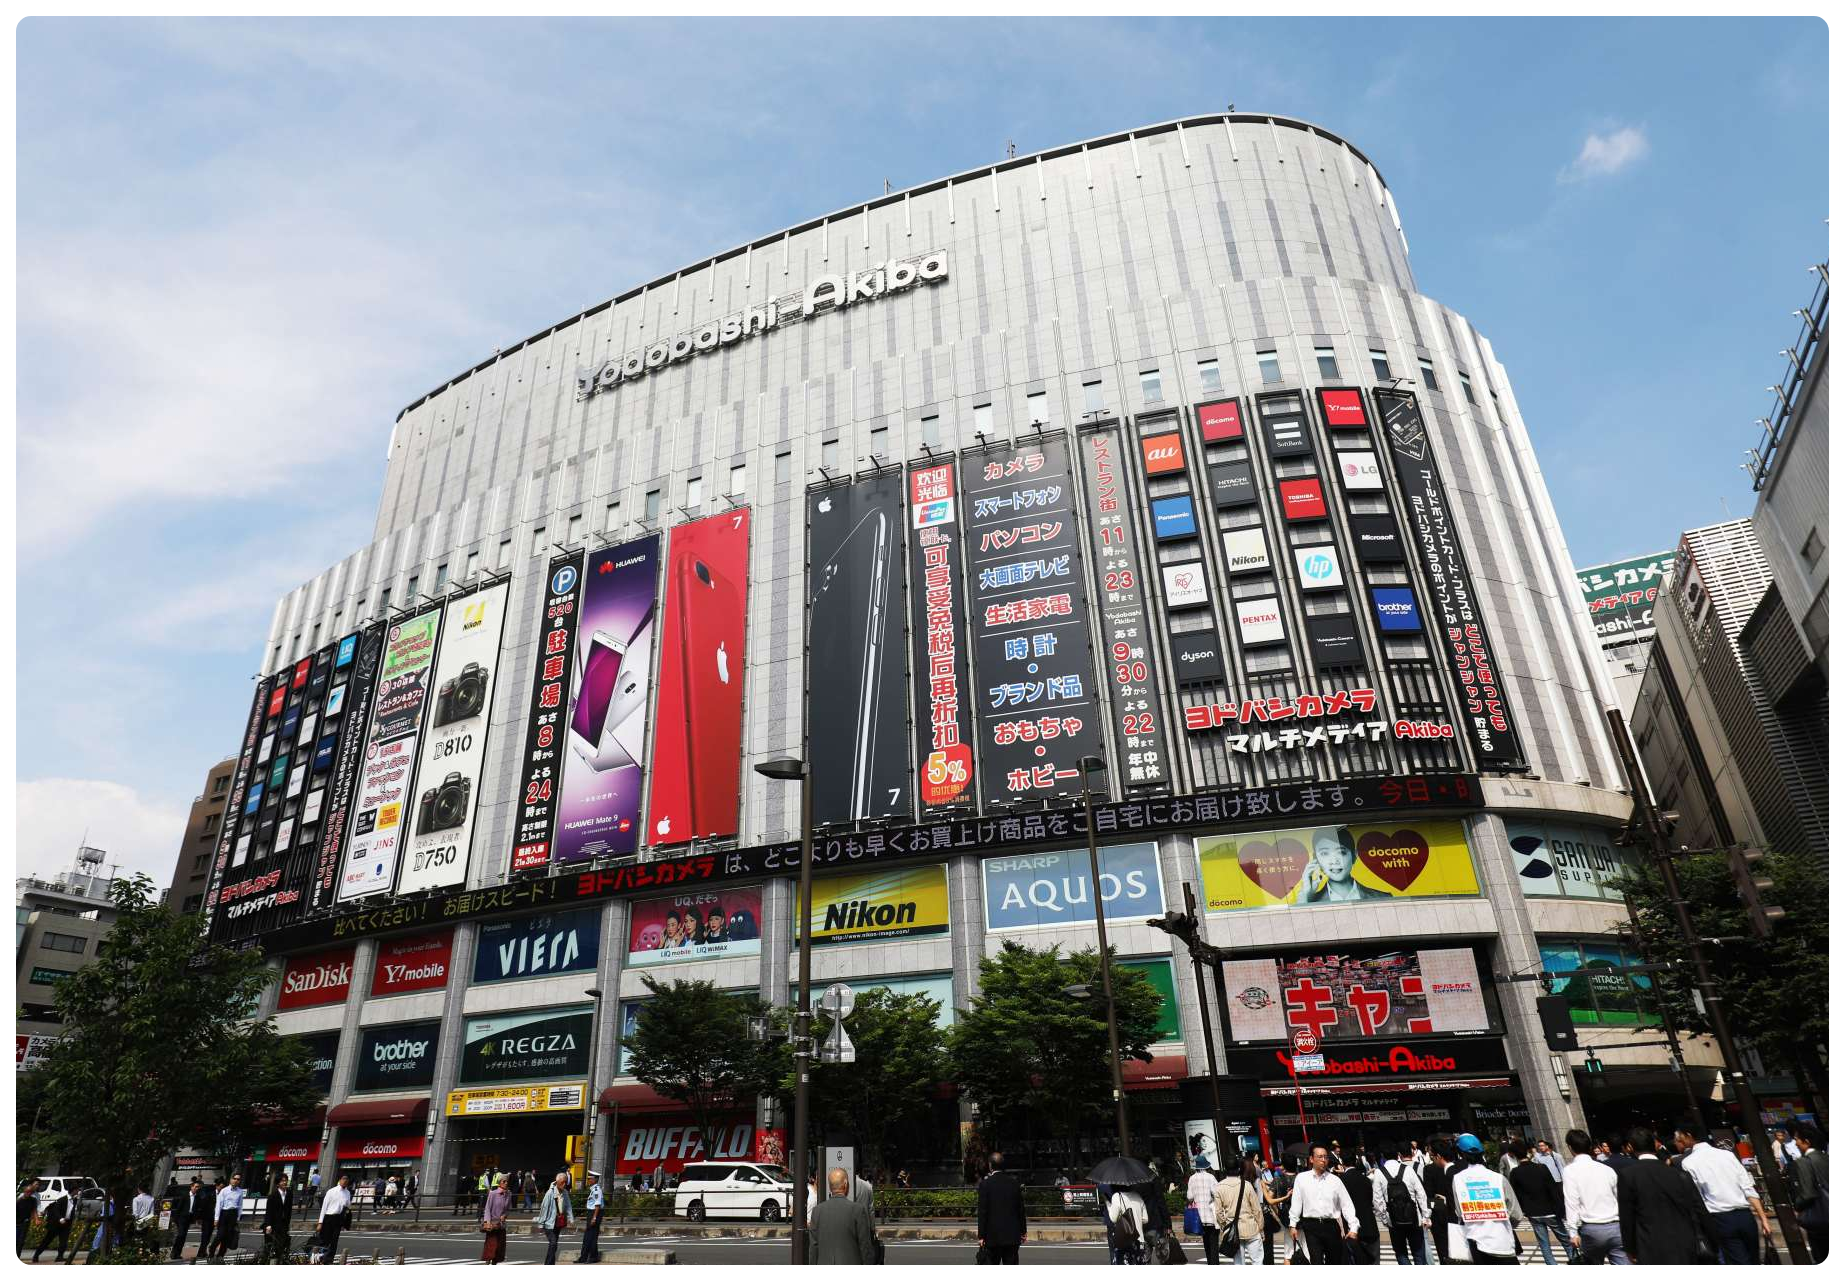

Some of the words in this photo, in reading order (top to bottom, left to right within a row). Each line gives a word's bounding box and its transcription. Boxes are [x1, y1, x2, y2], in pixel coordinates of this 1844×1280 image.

[576, 249, 948, 396] Yodobashi-Akiba
[1206, 416, 1235, 426] docomo
[1147, 446, 1179, 461] au
[983, 453, 1045, 481] カメラ
[1092, 436, 1118, 513] レストラン街
[1361, 466, 1378, 474] LG
[916, 468, 948, 486] 欢迎
[1218, 477, 1248, 486] HITACHI
[917, 485, 949, 501] 光临
[974, 485, 1061, 518] スマートフォン
[732, 516, 743, 530] 7
[1099, 514, 1122, 525] あさ
[1157, 512, 1189, 521] Panasonic
[980, 521, 1063, 552] パソコン
[1099, 526, 1124, 545] 11
[1361, 533, 1395, 542] Microsoft
[1102, 546, 1127, 557] 時から
[615, 554, 646, 569] HUAWEI
[1106, 559, 1129, 570] よる
[1231, 555, 1265, 566] Nikon
[1308, 555, 1330, 579] hp
[979, 554, 1070, 591] 大画面テレビ
[1104, 570, 1135, 592] 23
[1108, 592, 1134, 603] 時まで
[547, 601, 574, 618] 520
[985, 593, 1073, 627] 生活家電
[1104, 609, 1142, 621] Yodobashi
[1378, 603, 1413, 612] brother
[462, 619, 482, 632] Nikon
[553, 616, 564, 627] 台
[1114, 616, 1136, 626] Akiba
[1242, 613, 1277, 625] PENTAX
[1114, 627, 1138, 639] あさ
[923, 544, 960, 750] 可享受免税后再折扣
[1004, 632, 1057, 660] 時計
[1112, 641, 1145, 663] 9時
[1181, 650, 1214, 663] dyson
[540, 629, 568, 708] 駐車場
[1116, 661, 1147, 684] 30
[990, 674, 1083, 709] ブランド品
[1121, 685, 1148, 697] 分から
[1124, 699, 1148, 712] よる
[1184, 687, 1377, 731] ヨドバシカメラ
[537, 712, 558, 725] あさ
[1122, 712, 1155, 736] 22
[537, 725, 554, 748] 8
[994, 716, 1083, 745] おもちゃ
[1227, 721, 1389, 754] マルチメディア
[1394, 719, 1454, 740] Akiba
[433, 733, 473, 761] D810
[1127, 736, 1154, 748] 時まで
[532, 750, 554, 762] 時から
[1128, 750, 1158, 766] 年中
[531, 767, 551, 780] よる
[928, 751, 967, 784] 5%
[1129, 765, 1161, 781] 無休
[1007, 763, 1080, 791] ホビー
[526, 778, 551, 805] 24
[888, 788, 901, 806] 7
[525, 806, 547, 818] 時まで
[565, 818, 594, 831] HUAWEI
[595, 816, 611, 825] Mate
[613, 814, 619, 822] 9
[413, 845, 456, 871] D750
[1368, 845, 1419, 858] docomo
[989, 855, 1060, 873] SHARP
[1382, 857, 1410, 869] with
[577, 857, 715, 895] ヨドバシカメラ
[1000, 870, 1148, 912] AQUOS
[227, 892, 278, 919] マルチメディア
[1209, 897, 1243, 908] docomo
[823, 900, 917, 932] Nikon
[831, 928, 911, 942] http://www.nikon-image.com/
[499, 928, 579, 977] VIERA
[284, 961, 351, 994] SanDisk
[373, 1039, 429, 1062] brother
[479, 1041, 495, 1057] 4K
[501, 1033, 577, 1056] REGZA
[379, 1063, 388, 1072] at
[388, 1062, 403, 1073] your
[403, 1060, 416, 1071] side
[278, 1145, 307, 1158] docomo
[363, 1141, 397, 1155] docomo
